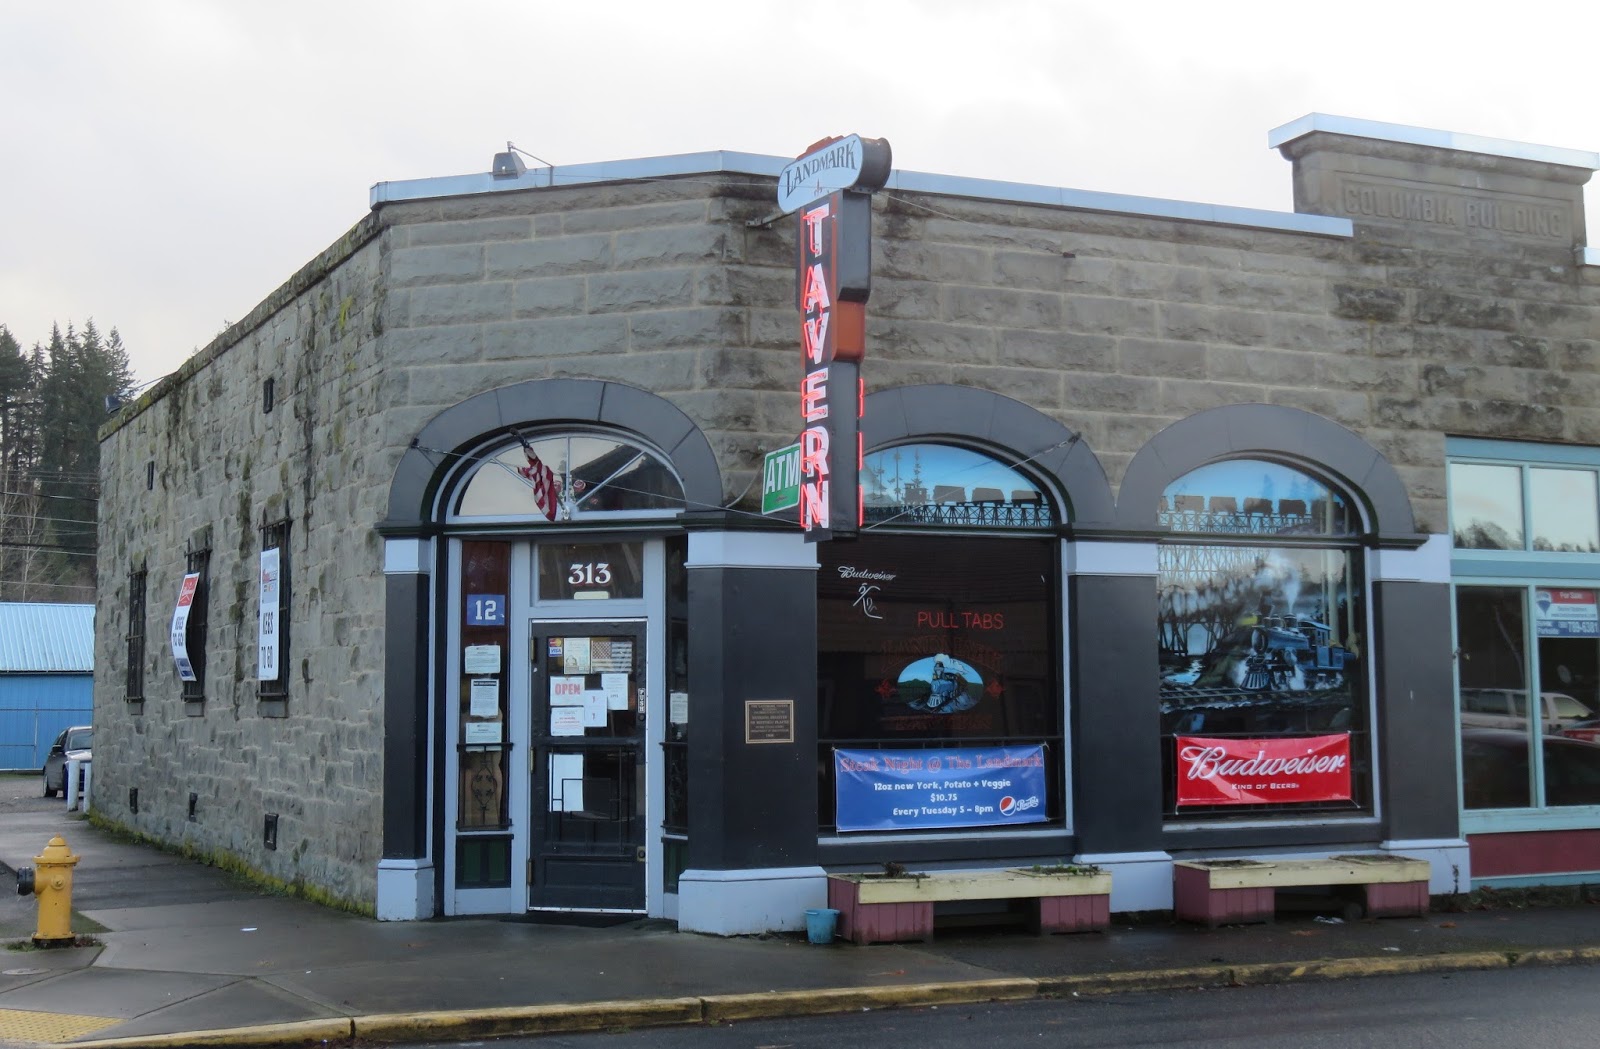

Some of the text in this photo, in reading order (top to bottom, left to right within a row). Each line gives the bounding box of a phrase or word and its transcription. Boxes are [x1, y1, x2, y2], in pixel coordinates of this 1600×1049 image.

[785, 139, 857, 199] LANDMARK
[1344, 185, 1563, 238] COLUMBIA BUILDING
[801, 203, 831, 532] TAVERN
[765, 450, 800, 495] ATM
[568, 562, 611, 585] 313
[837, 565, 897, 581] Budweiser
[475, 600, 497, 621] 12
[917, 611, 1004, 630] PULL TABS
[554, 683, 581, 695] OPEN
[840, 753, 1043, 775] Steak Night @ The Landmark
[1180, 746, 1346, 781] Budweiser
[874, 782, 893, 791] 12oz
[917, 781, 942, 791] York,
[944, 780, 972, 789] Potato
[981, 778, 1011, 790] Veggie
[930, 793, 957, 802] $10.75
[893, 807, 918, 817] Every
[921, 806, 957, 817] Tuesday
[974, 805, 994, 816] 8pm
